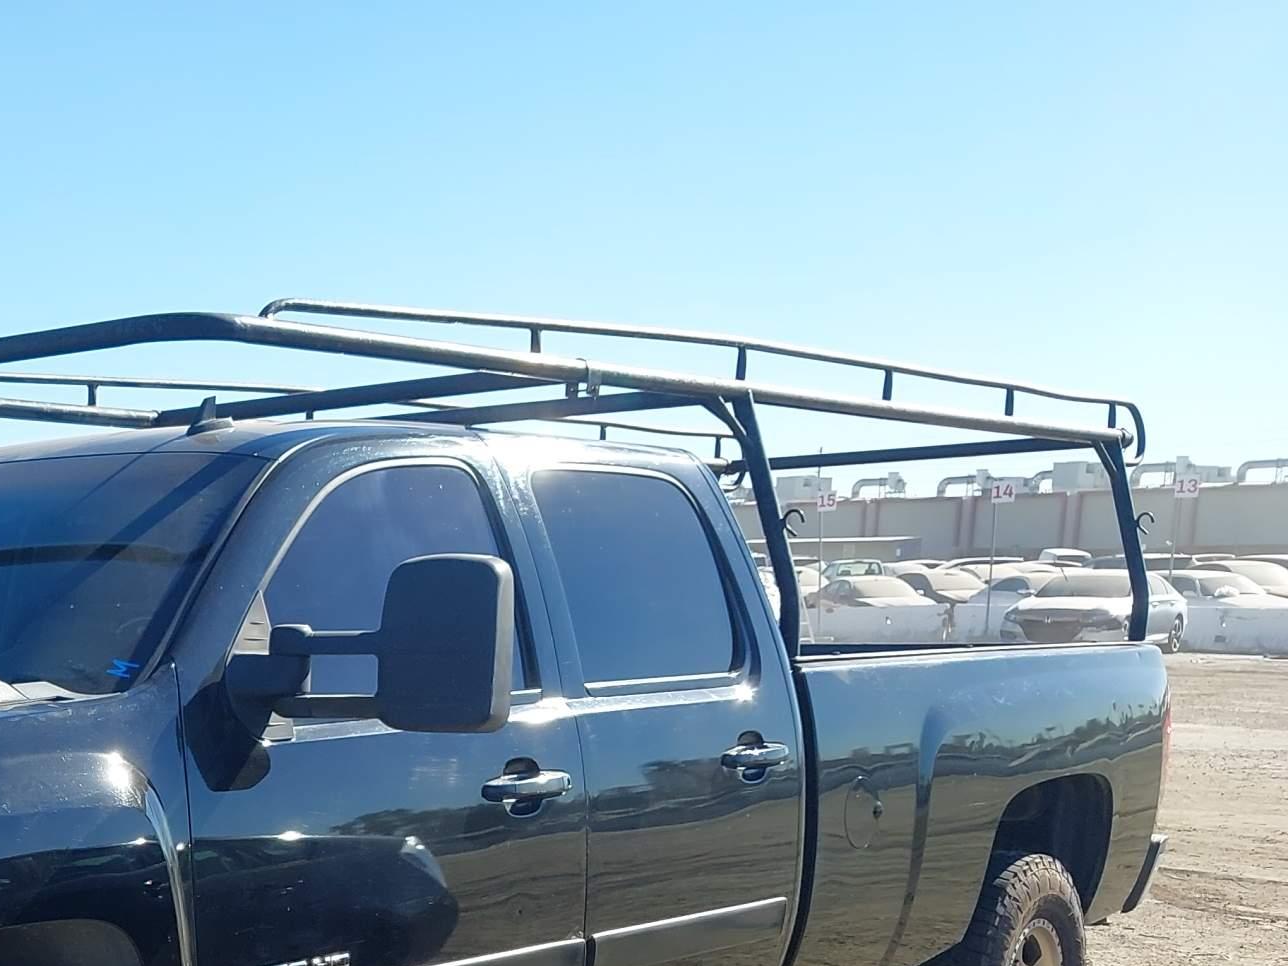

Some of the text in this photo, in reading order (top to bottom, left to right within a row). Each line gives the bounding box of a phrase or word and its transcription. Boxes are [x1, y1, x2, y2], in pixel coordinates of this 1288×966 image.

[993, 484, 1014, 499] 14
[1176, 479, 1198, 494] 13
[818, 494, 836, 508] 15
